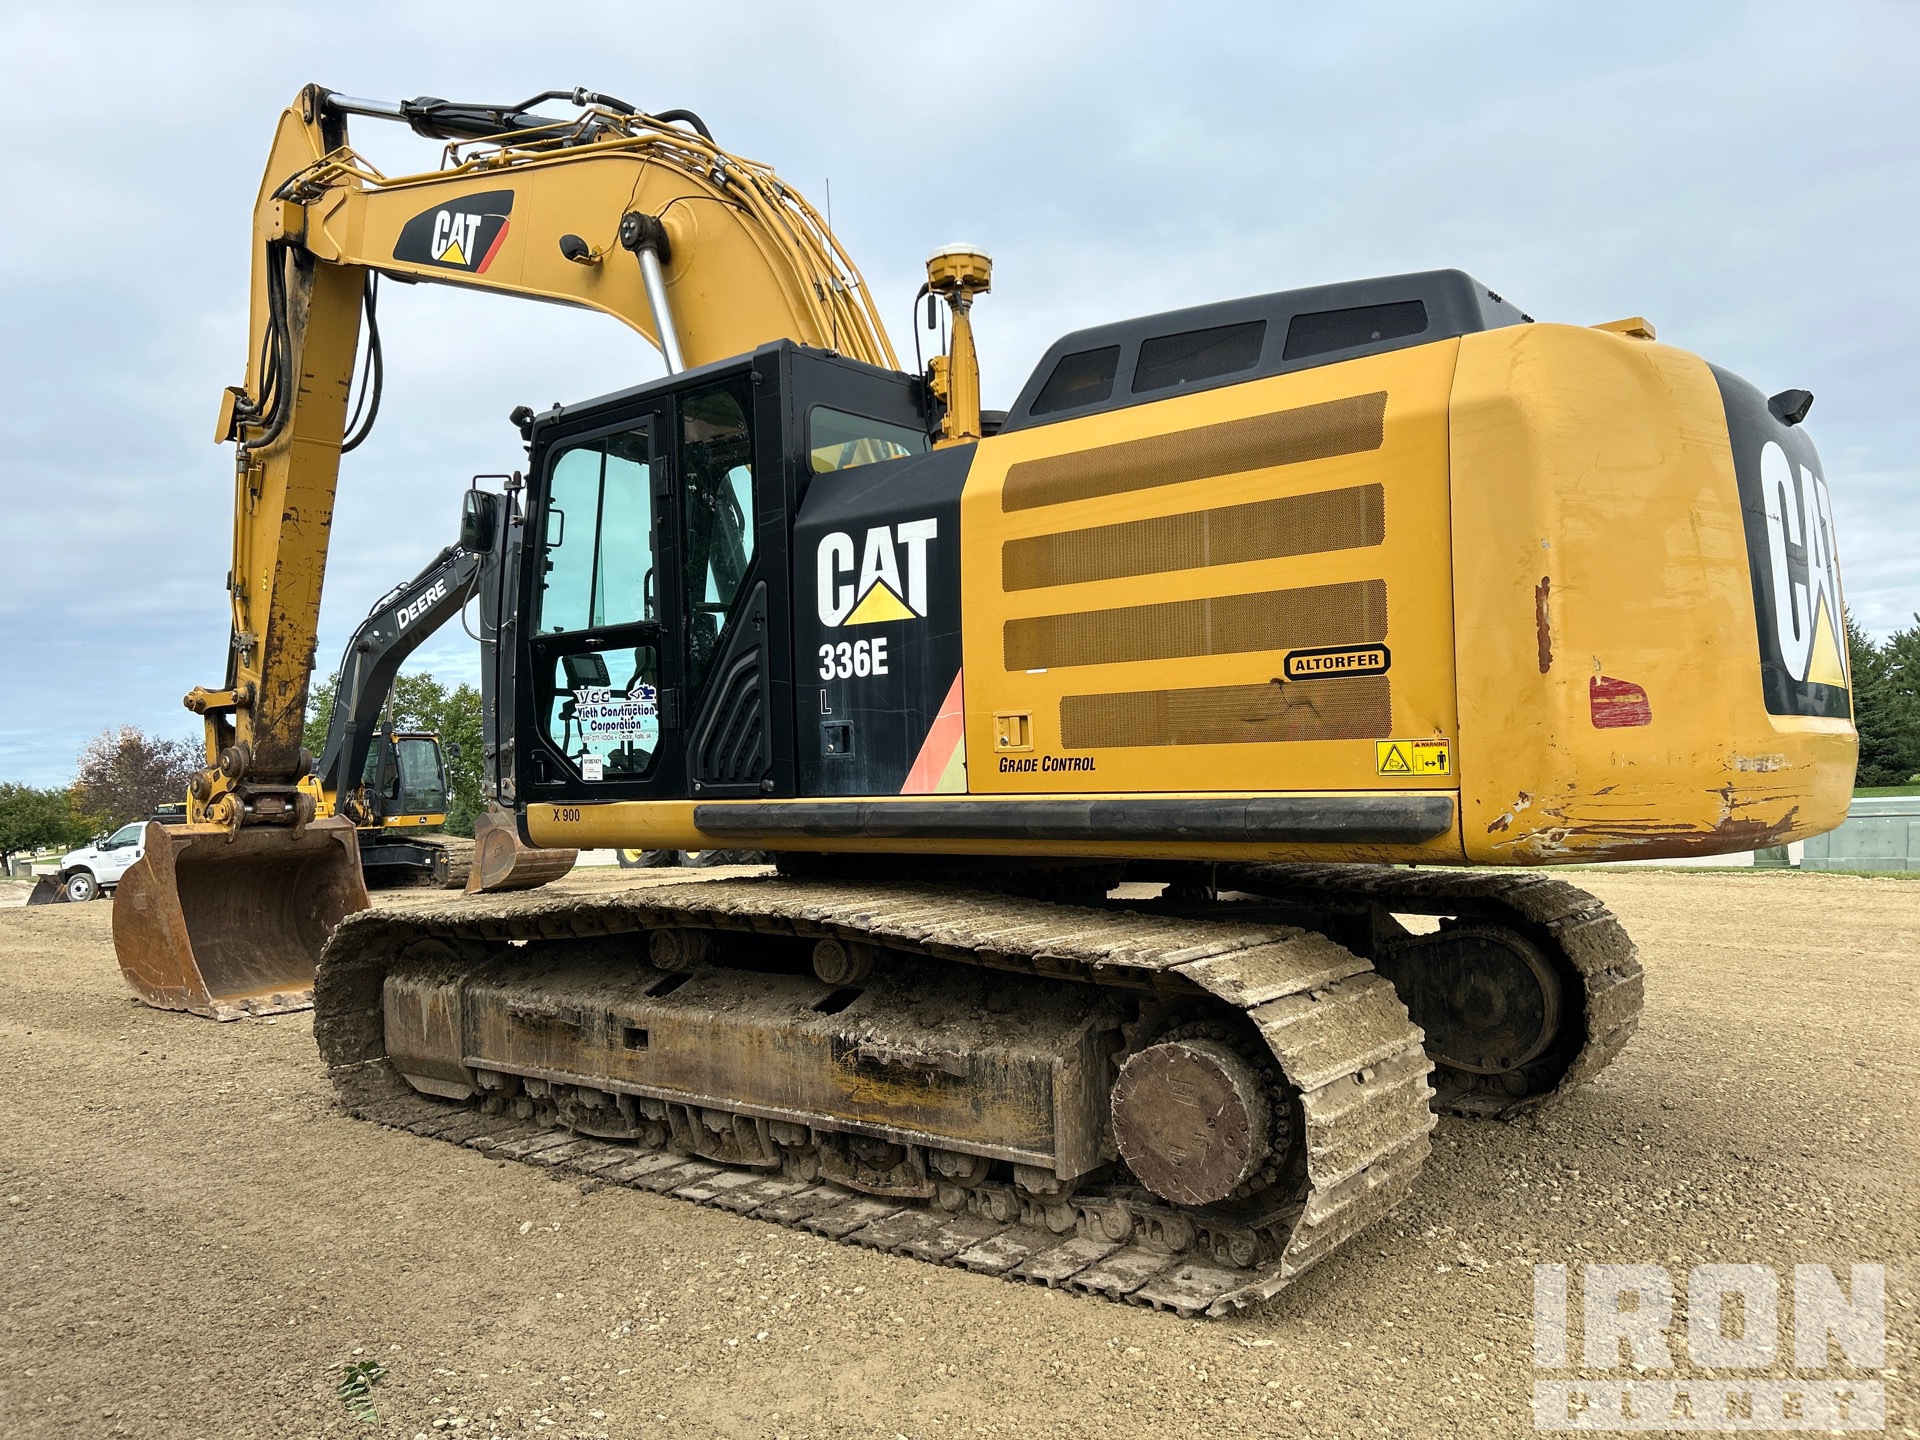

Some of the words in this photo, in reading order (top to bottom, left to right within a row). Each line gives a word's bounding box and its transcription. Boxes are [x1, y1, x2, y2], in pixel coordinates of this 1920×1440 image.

[431, 209, 482, 266] CAT
[817, 517, 938, 628] CAT
[396, 578, 447, 630] DEERE
[818, 637, 889, 681] 336E
[1295, 653, 1379, 671] ALTORFER
[575, 690, 610, 704] VCC
[578, 706, 598, 719] Vieth
[600, 703, 655, 718] Construction
[590, 718, 641, 733] Corporation
[999, 757, 1038, 773] GRADE
[1041, 755, 1096, 772] CONTROL
[553, 808, 560, 822] X
[563, 808, 580, 822] 900
